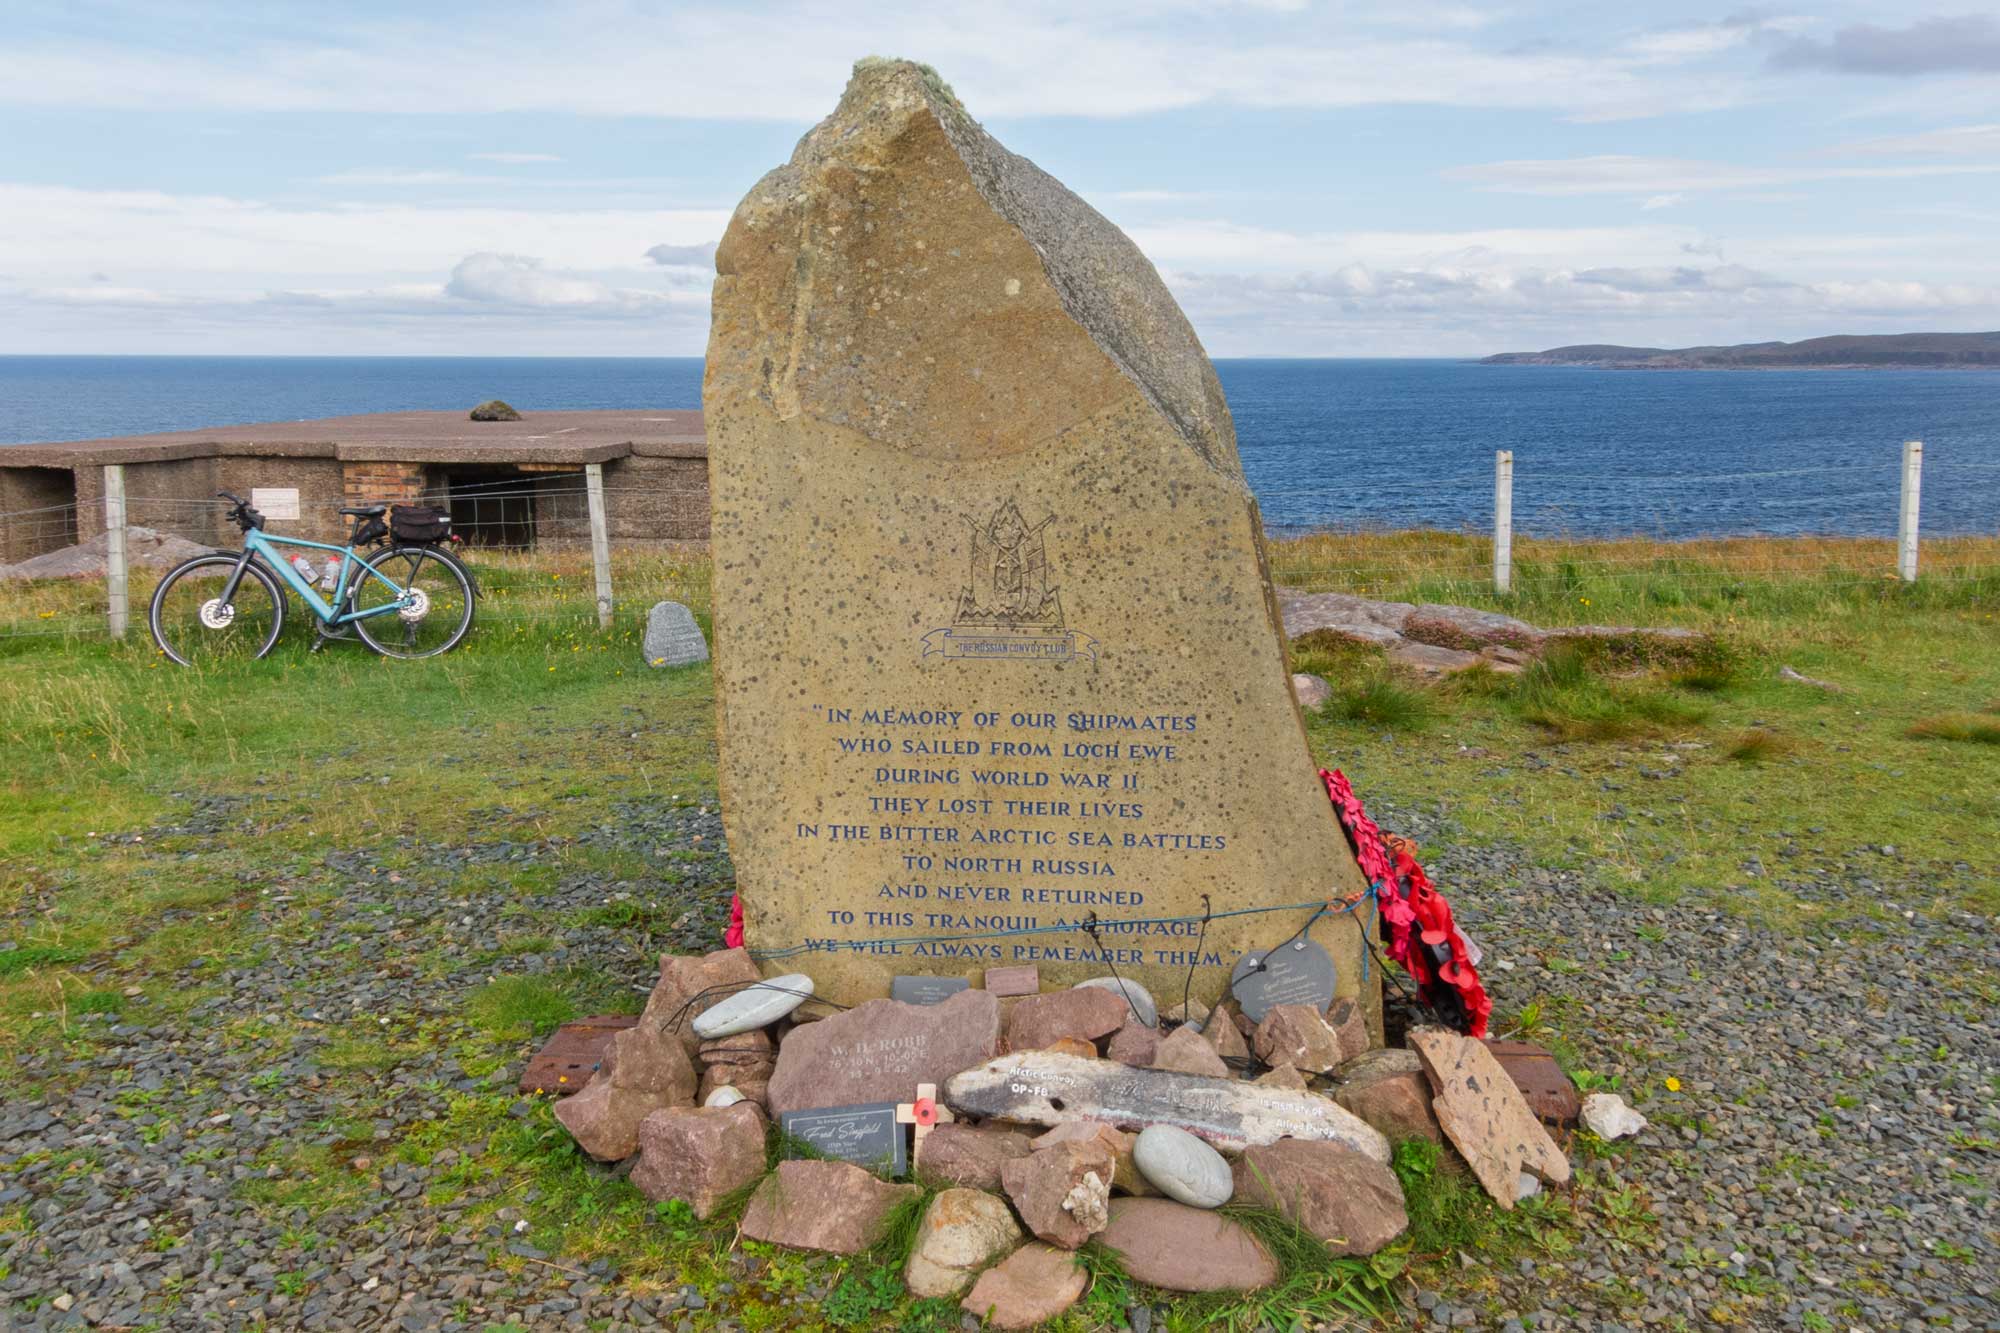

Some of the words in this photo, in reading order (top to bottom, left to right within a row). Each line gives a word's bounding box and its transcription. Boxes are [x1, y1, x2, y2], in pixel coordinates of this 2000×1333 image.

[975, 643, 1008, 653] RUSSIAN
[1009, 643, 1041, 653] CONVOY
[861, 709, 961, 727] MEMORY
[973, 711, 999, 727] OF
[1010, 712, 1056, 729] OUR
[1067, 713, 1196, 732] SHIPMATES
[838, 737, 893, 753] WHO
[902, 739, 980, 755] SAILED
[990, 742, 1052, 758] FROM
[1063, 743, 1119, 759] LOCH
[1129, 744, 1175, 762] EWE
[875, 767, 959, 784] DURING
[971, 771, 1050, 787] WORLD
[1060, 773, 1110, 790] WAR
[1123, 774, 1137, 791] II
[869, 796, 928, 814] THEY
[938, 800, 992, 815] LOST
[1004, 800, 1070, 816] THEIR
[1080, 802, 1144, 820] LIVES
[797, 822, 820, 838] IN
[828, 824, 868, 841] THE
[880, 826, 959, 843] BITTER
[971, 829, 1055, 845] ARCTIC
[1067, 832, 1113, 848] SEA
[1123, 832, 1226, 851] BATTLES
[903, 855, 933, 871] TO
[944, 857, 1022, 874] NORTH
[1032, 859, 1115, 877] RUSSIA
[879, 884, 928, 900] AND
[937, 886, 1010, 902] NEVER
[1021, 888, 1144, 906] RETURNED
[828, 911, 855, 925] TO
[865, 911, 913, 928] THIS
[804, 938, 838, 953] WE
[848, 938, 902, 955] WILL
[913, 941, 1002, 959] ALWAYS
[1013, 945, 1143, 965] REMEMBER
